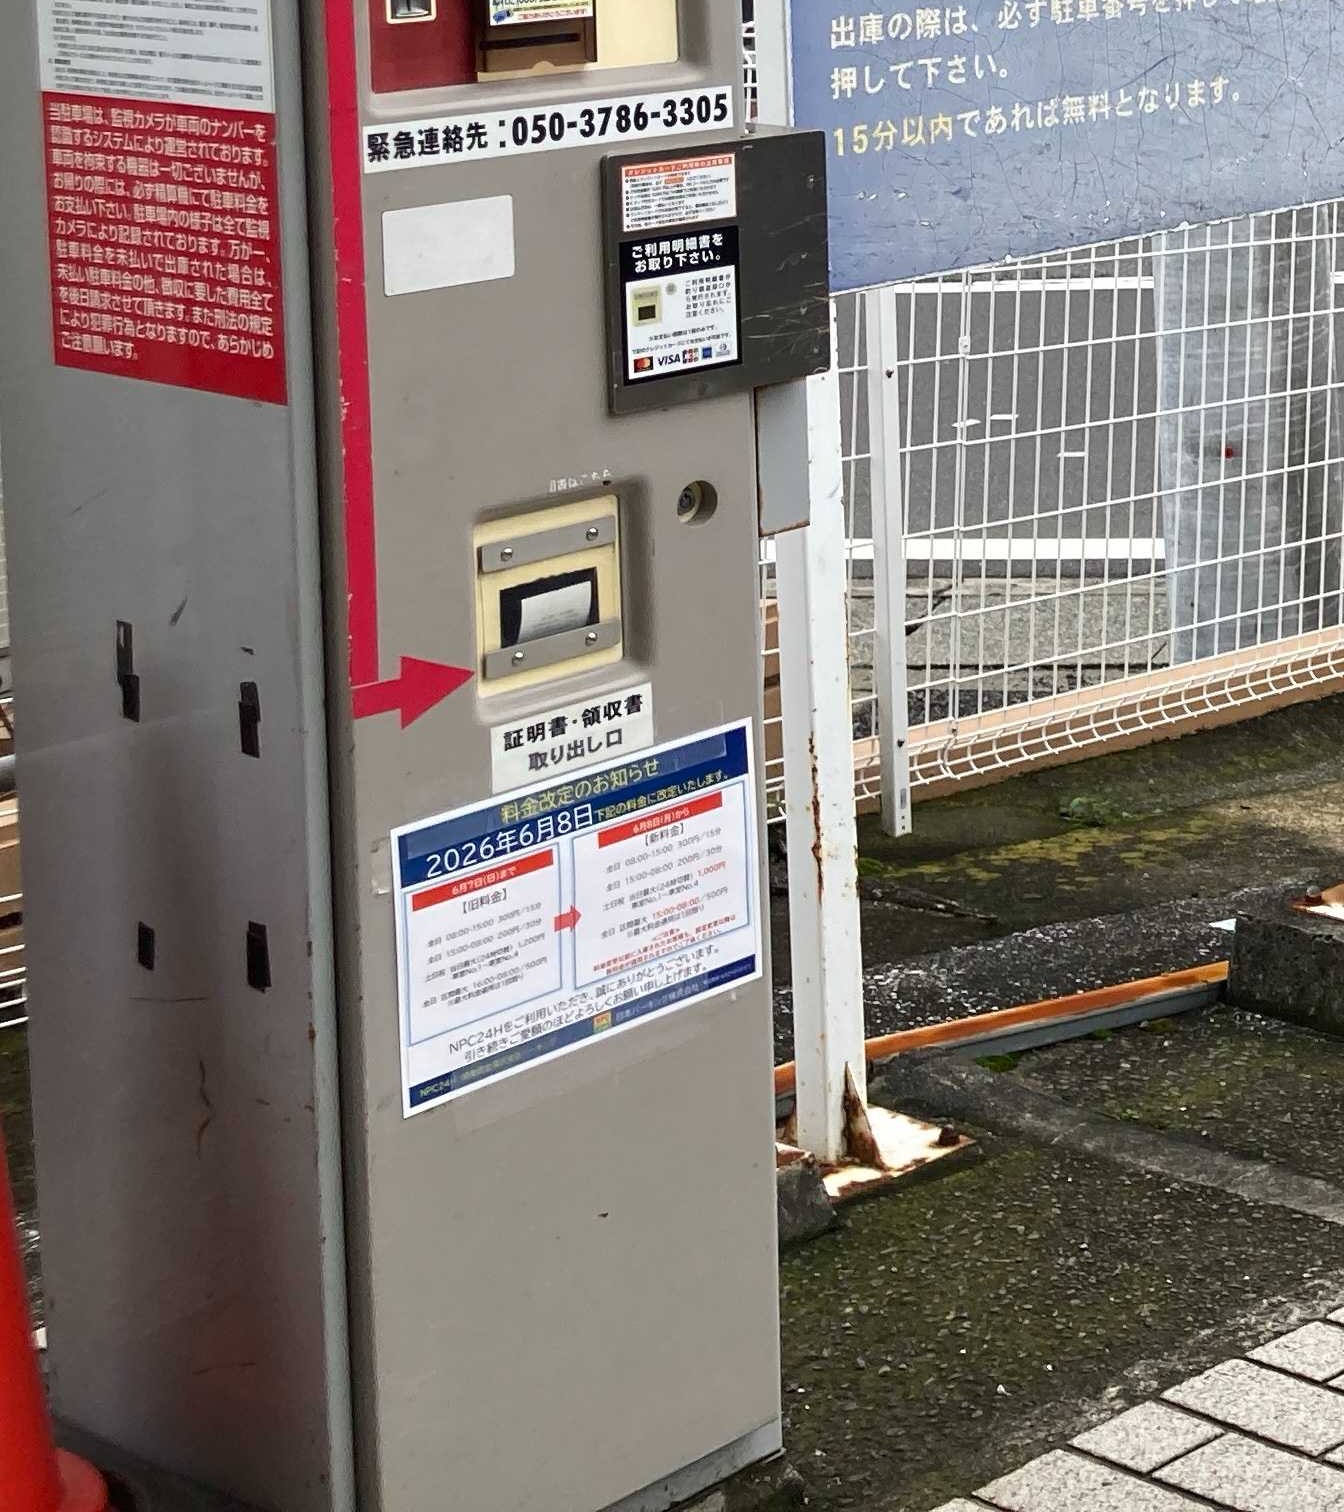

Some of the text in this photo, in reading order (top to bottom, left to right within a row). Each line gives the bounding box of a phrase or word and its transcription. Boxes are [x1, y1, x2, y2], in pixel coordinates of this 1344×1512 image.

[830, 53, 1010, 100] 押して下さい。
[833, 78, 1243, 156] 15分以内であれば無料となります。
[631, 233, 723, 259] ご利用明細書を
[634, 249, 721, 273] お取り下さい。
[658, 350, 681, 366] VISA
[504, 694, 643, 751] 証明書・領収書
[528, 728, 623, 772] 取り出し口
[500, 758, 660, 824] 料金改定のお知らせ
[426, 803, 594, 878] 2026年6月8日
